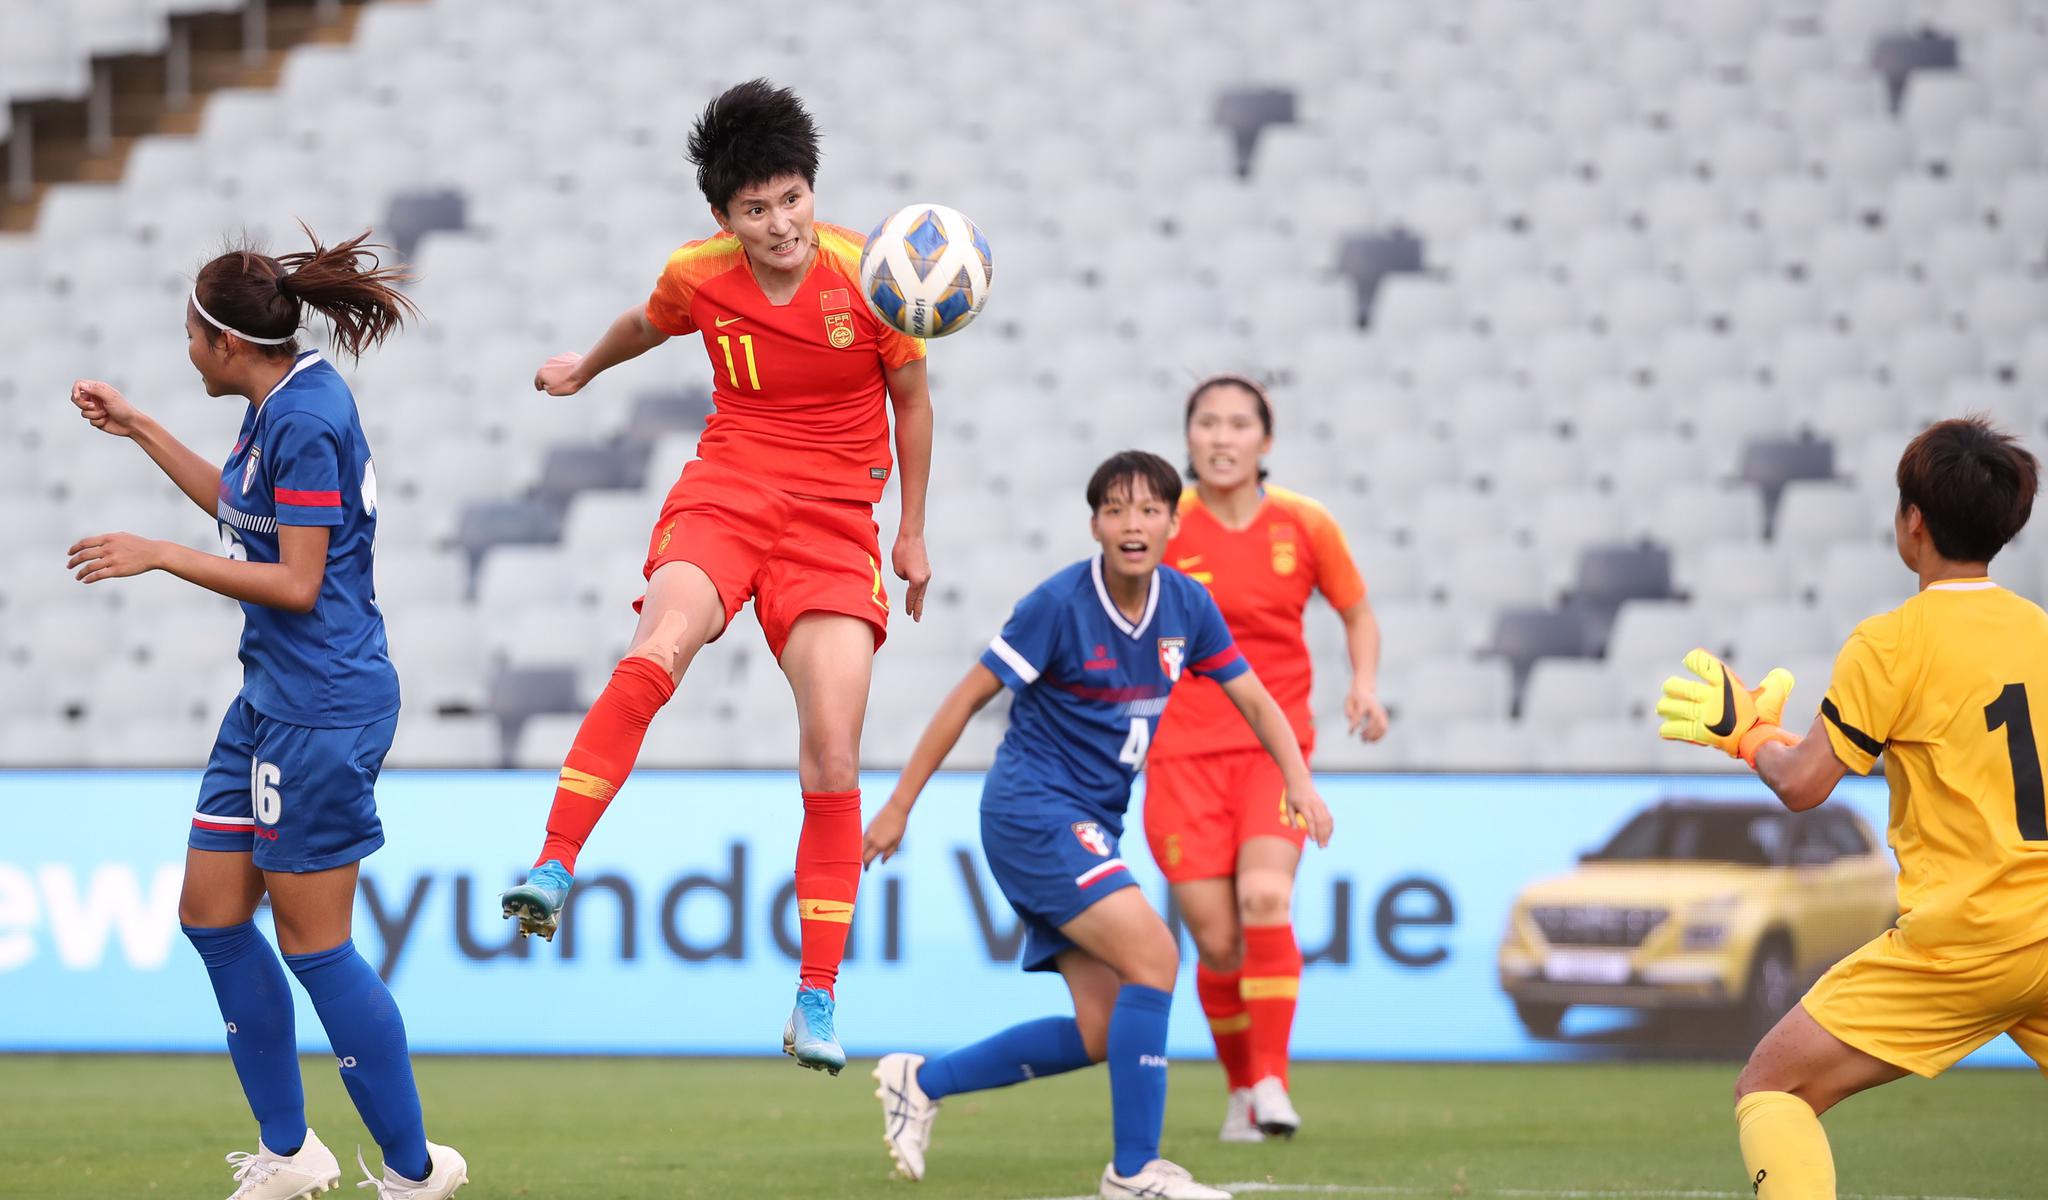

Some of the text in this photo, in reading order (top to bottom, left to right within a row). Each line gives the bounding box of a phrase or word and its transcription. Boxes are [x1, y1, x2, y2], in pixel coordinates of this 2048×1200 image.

[717, 334, 761, 391] 11
[1118, 716, 1150, 772] 4
[1983, 682, 2048, 841] 1
